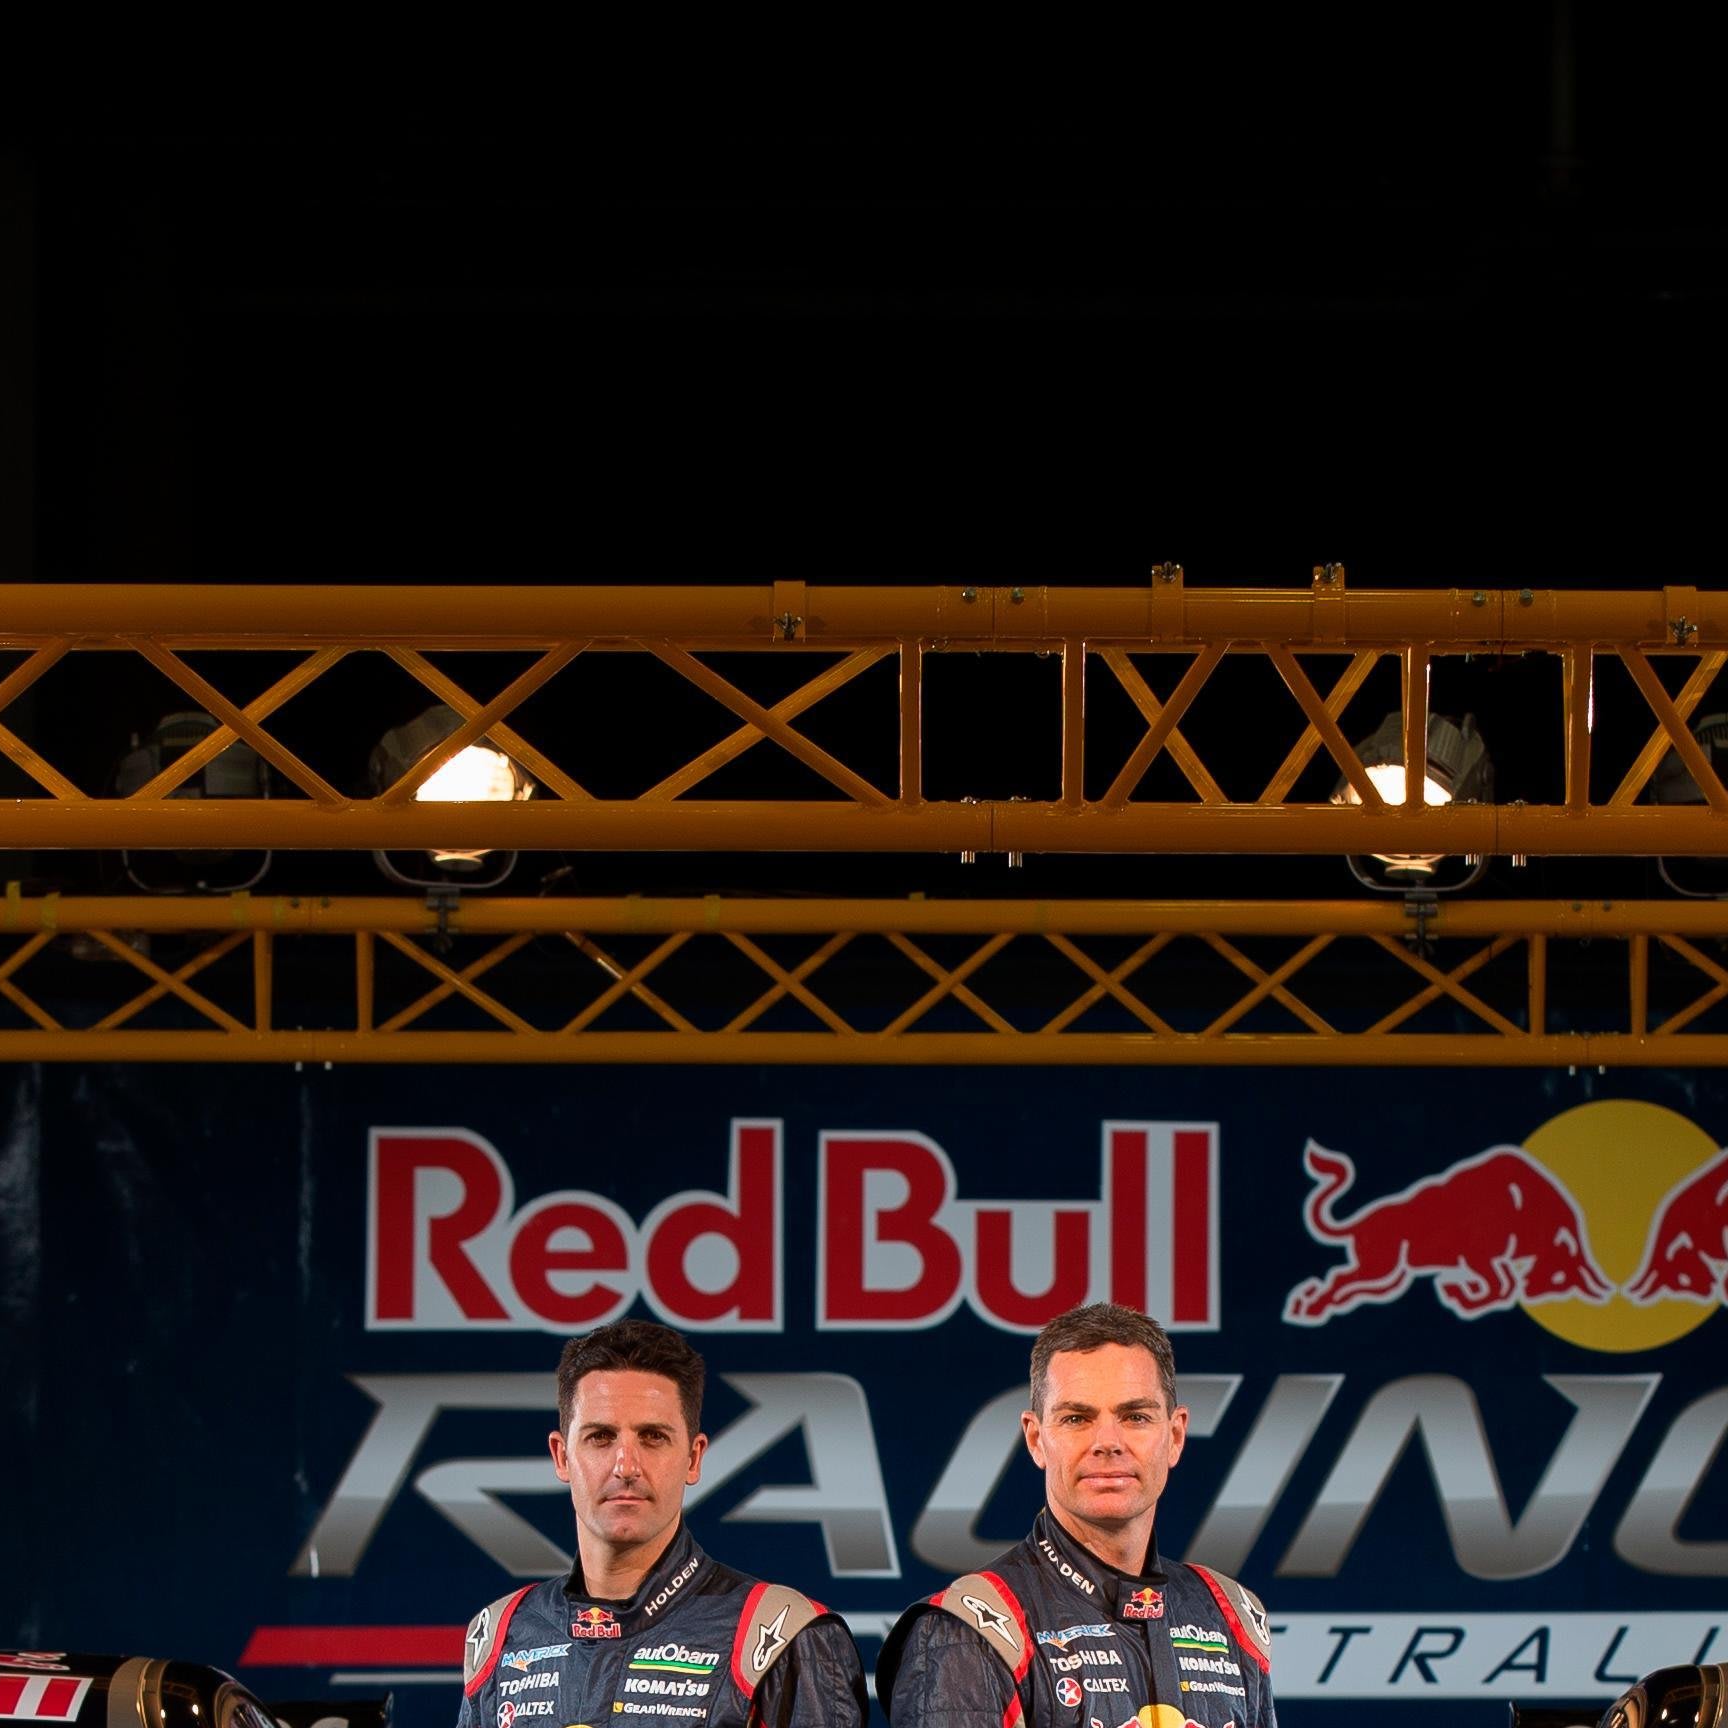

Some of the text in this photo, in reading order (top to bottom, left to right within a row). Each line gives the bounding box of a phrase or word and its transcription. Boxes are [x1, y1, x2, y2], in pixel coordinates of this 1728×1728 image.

[364, 1118, 1220, 1333] Red Bull
[644, 1557, 700, 1617] HOLDEN
[1123, 1603, 1146, 1619] Red
[572, 1623, 622, 1638] Red Bull
[1050, 1650, 1123, 1675] TOSHIBA
[1178, 1656, 1241, 1677] KOMATSU
[499, 1671, 560, 1697] TOSHIBA
[624, 1678, 710, 1697] KOMATSU
[1083, 1677, 1130, 1693] CALTEX
